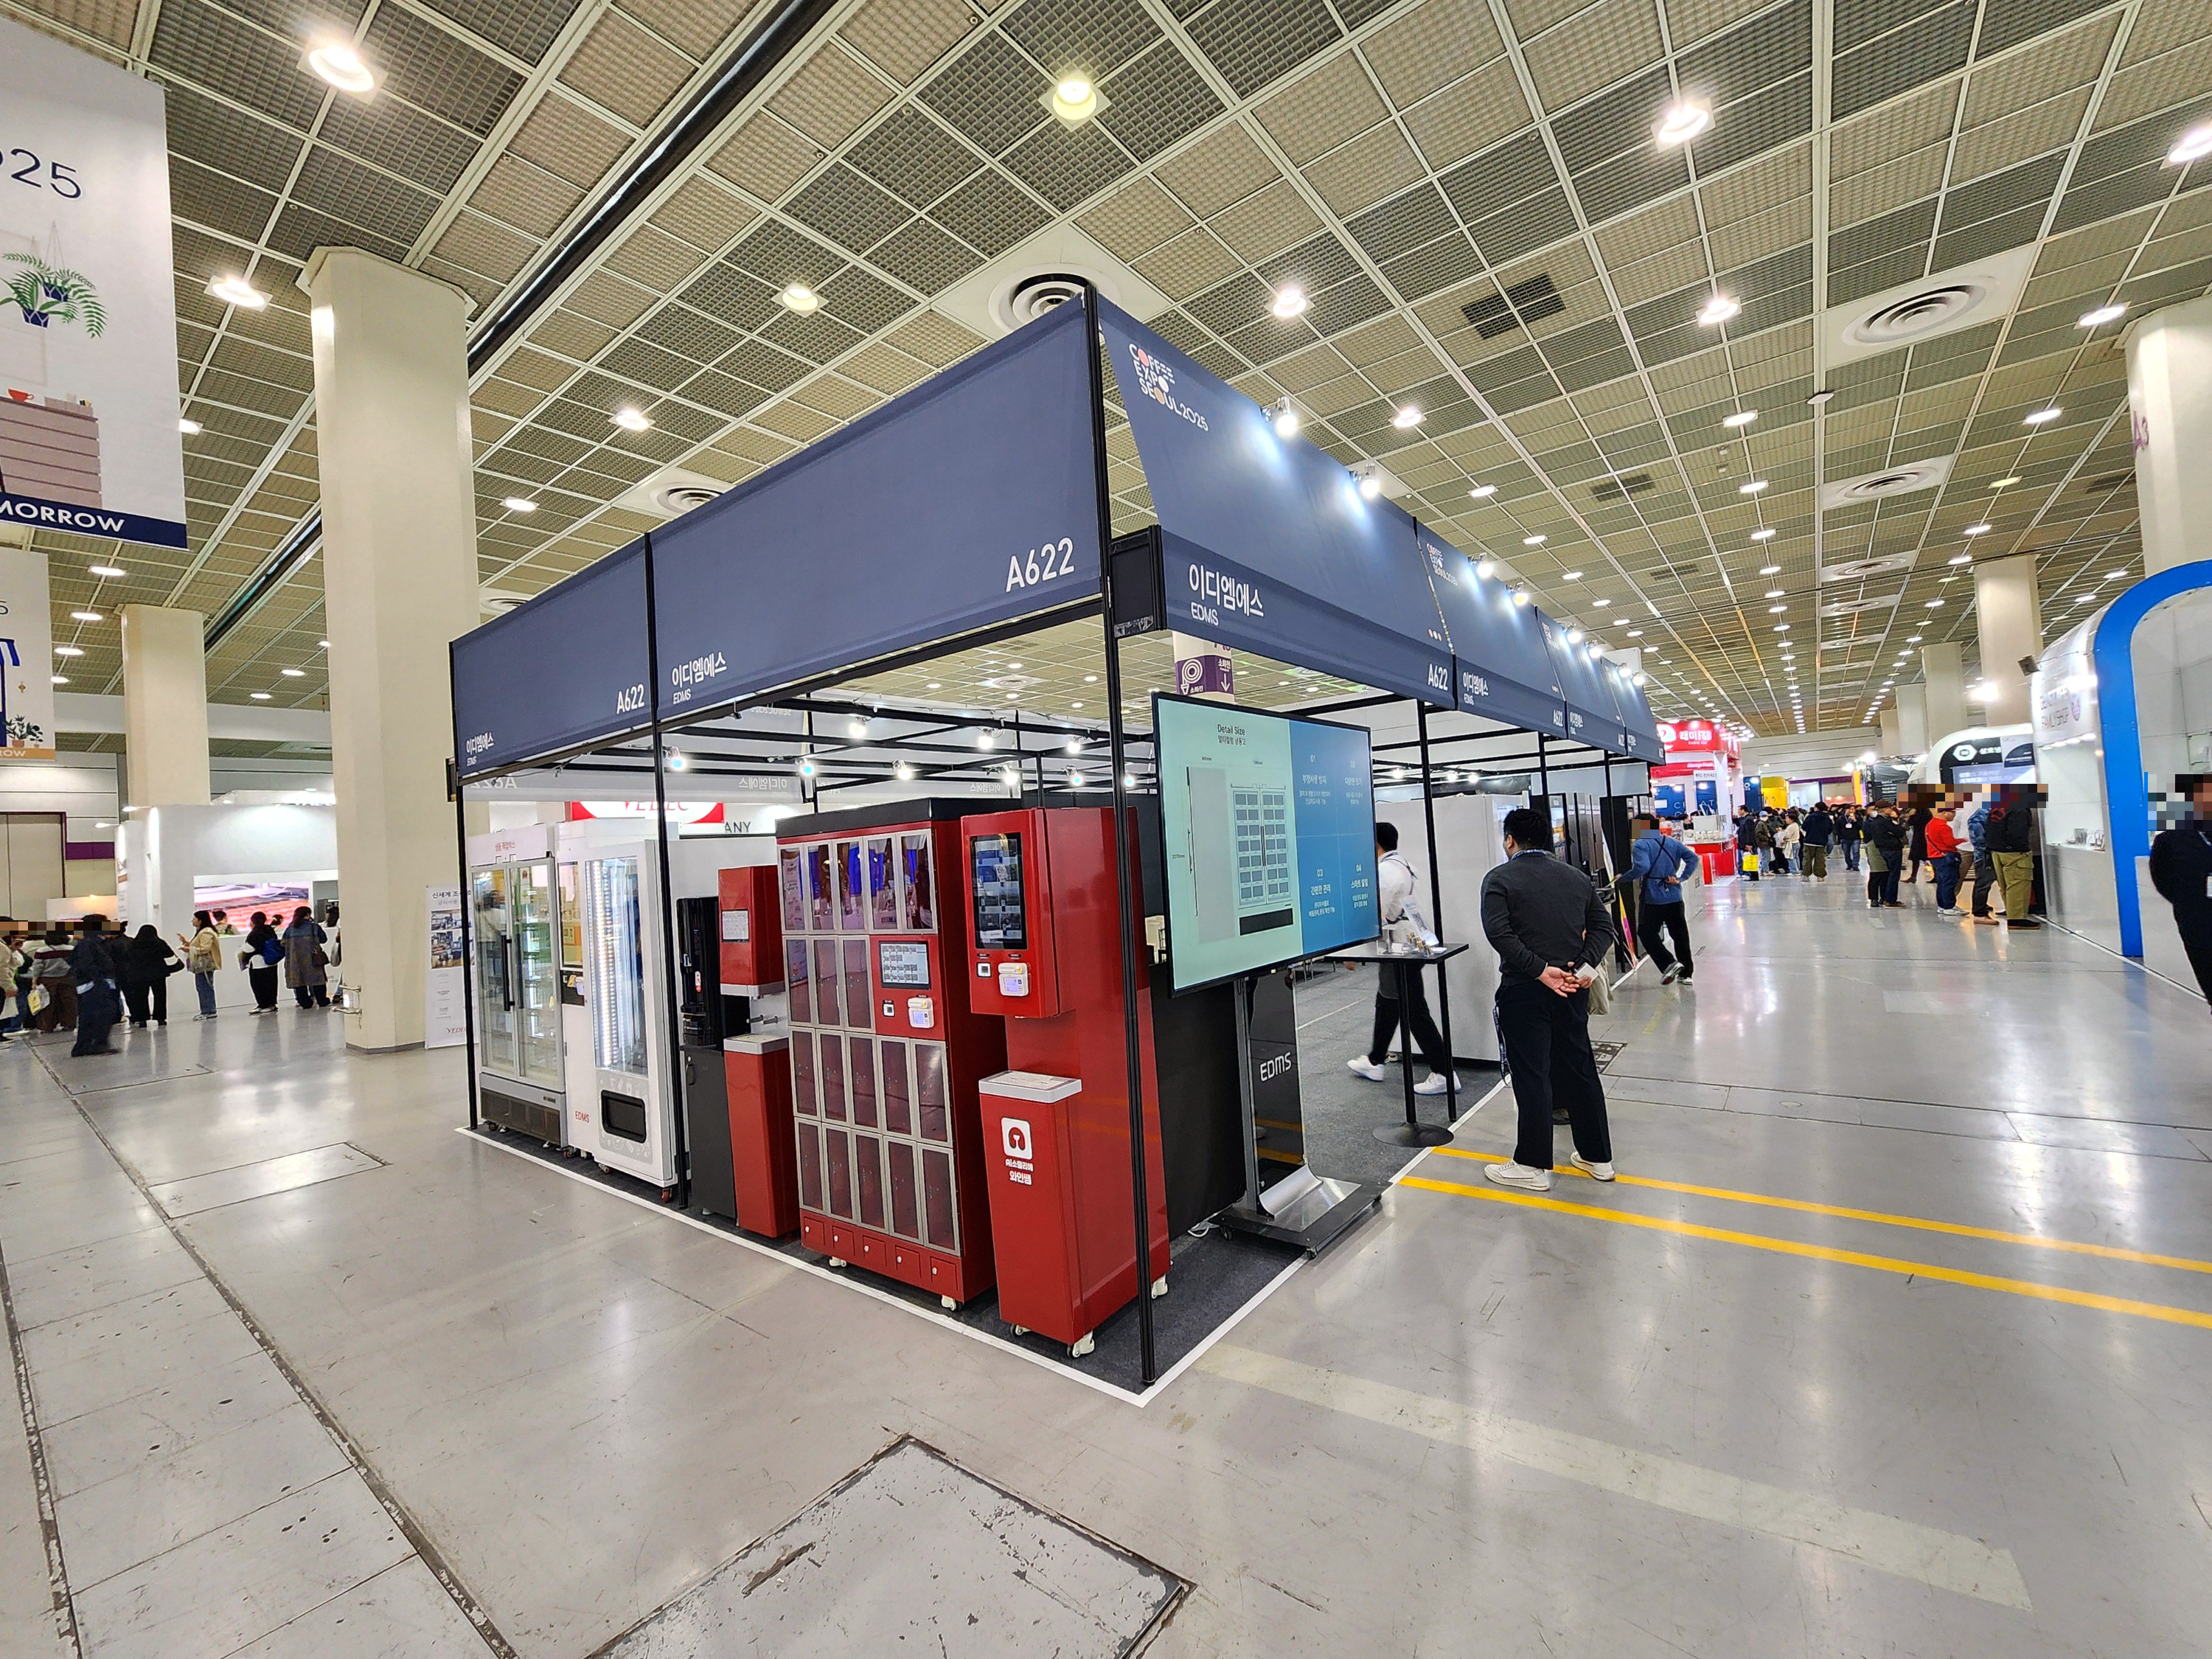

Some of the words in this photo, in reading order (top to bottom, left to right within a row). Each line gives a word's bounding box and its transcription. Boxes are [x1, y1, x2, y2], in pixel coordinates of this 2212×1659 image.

[0, 147, 81, 199] 25
[1129, 343, 1176, 385] COFFEE
[1133, 359, 1169, 393] EXPO
[1138, 377, 1209, 432] SEOUL2025
[1005, 537, 1075, 593] A622
[1189, 563, 1265, 617] 이디엠에스
[1191, 602, 1219, 627] EDMS
[672, 651, 728, 688] 이디엠에스
[1427, 664, 1448, 691] A622
[672, 689, 692, 705] EDMS
[1463, 671, 1489, 697] 이디엠에스
[616, 683, 645, 714] A622
[466, 731, 495, 754] 이디엠에스
[1217, 723, 1234, 734] Detail
[1234, 726, 1246, 736] Size
[1310, 754, 1316, 763] 01
[1316, 869, 1324, 877] 03
[1356, 863, 1362, 872] 04
[432, 891, 451, 899] 신세계
[1259, 1051, 1292, 1082] EDMS
[575, 1110, 590, 1124] EDMS
